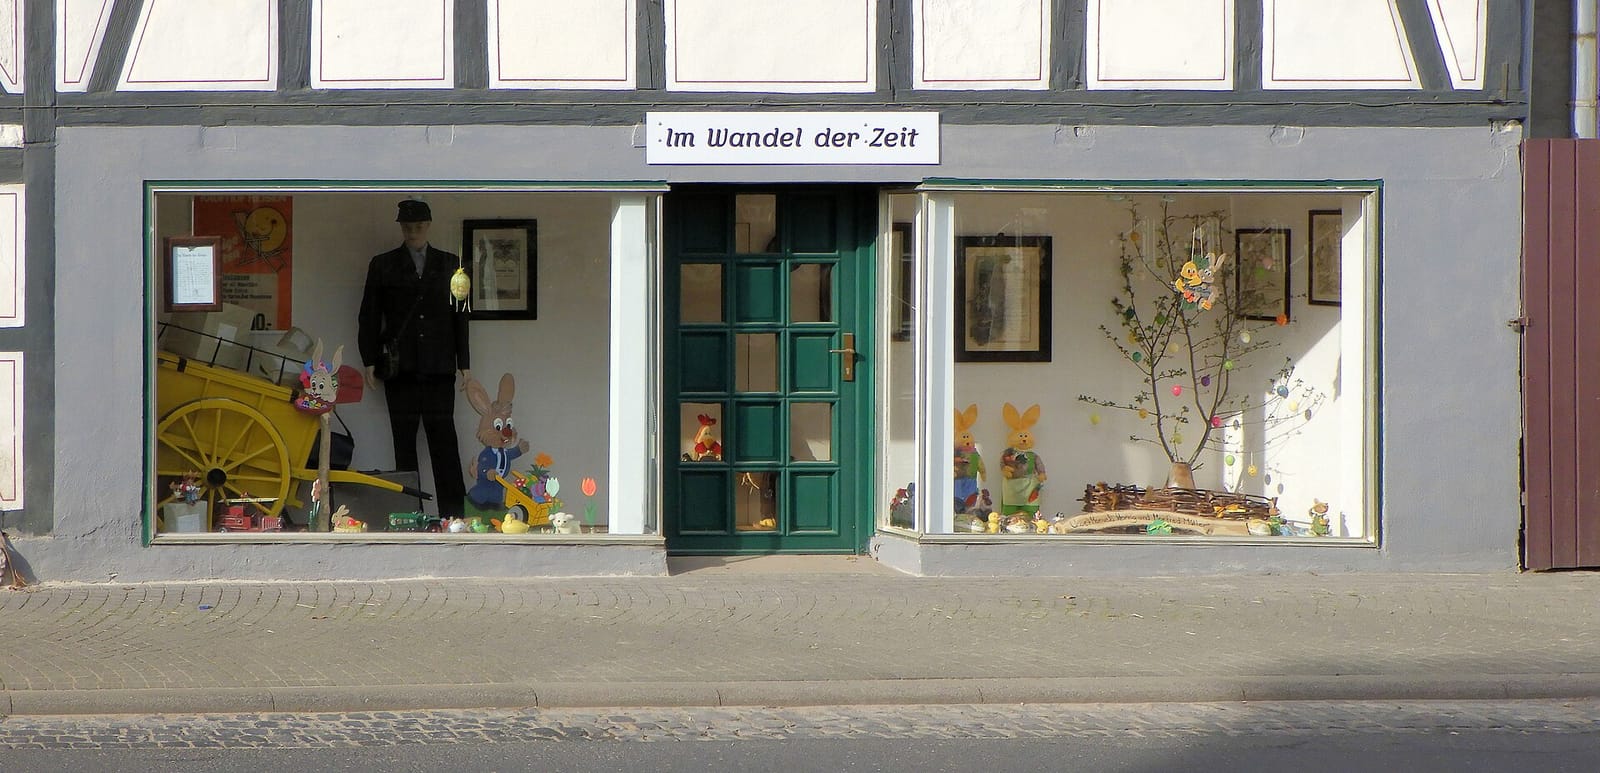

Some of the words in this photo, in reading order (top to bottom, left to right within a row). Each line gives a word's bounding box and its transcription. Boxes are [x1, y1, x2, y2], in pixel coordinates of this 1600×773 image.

[666, 128, 695, 148] Im
[707, 127, 803, 148] Wandel
[814, 127, 860, 148] der
[868, 126, 919, 148] Zeit
